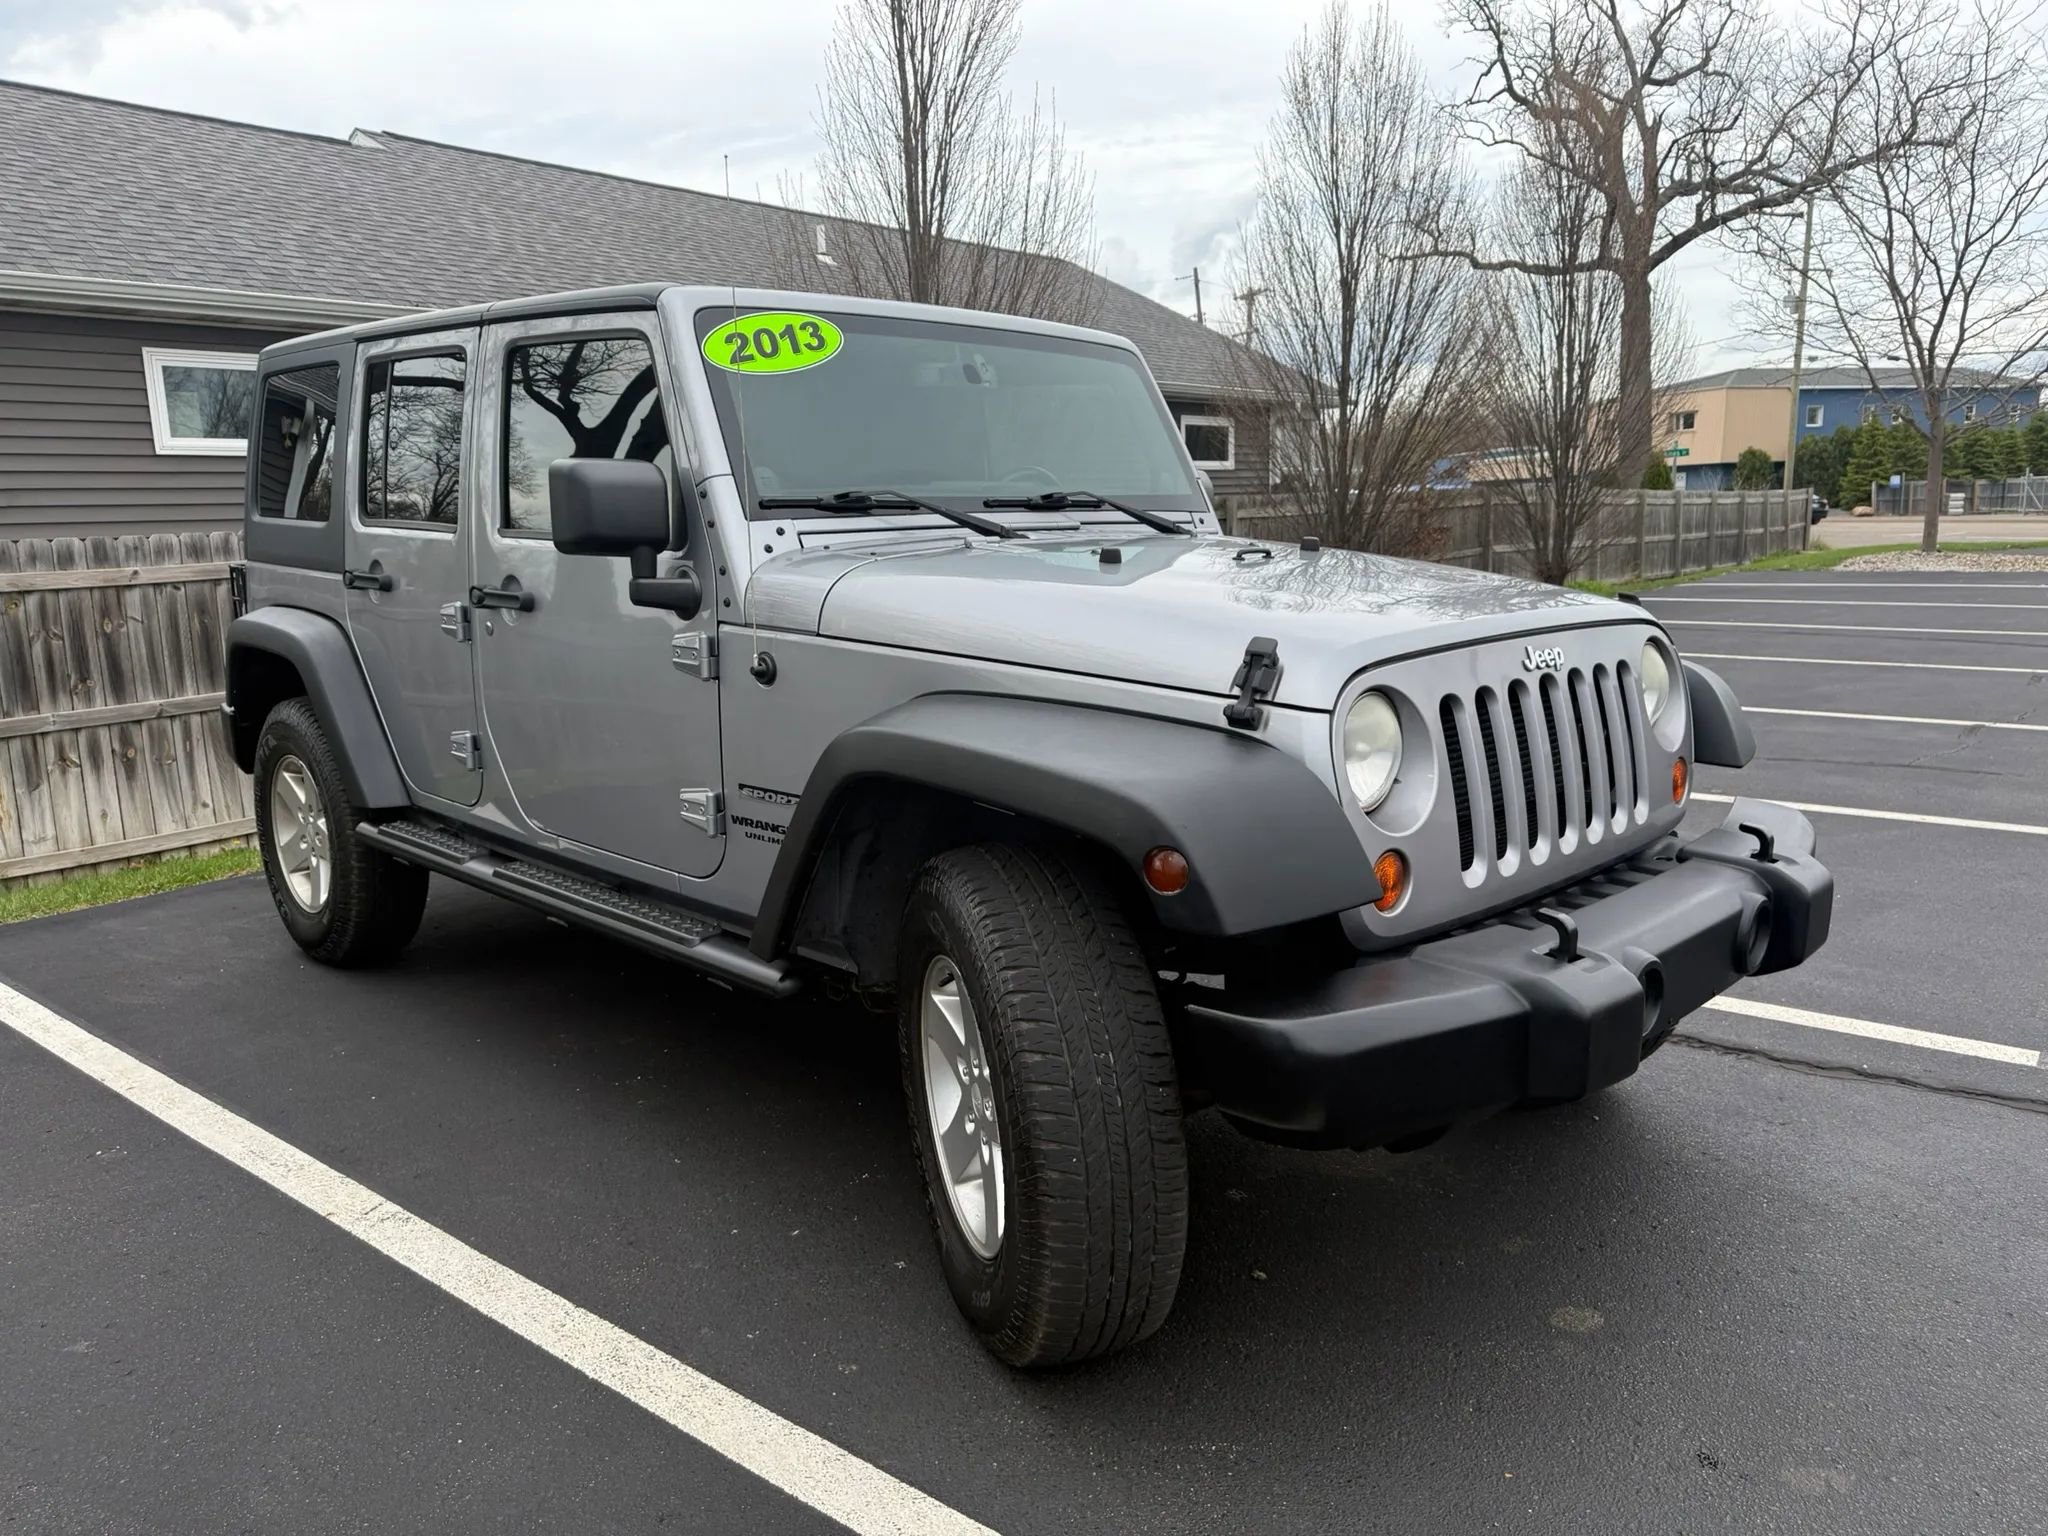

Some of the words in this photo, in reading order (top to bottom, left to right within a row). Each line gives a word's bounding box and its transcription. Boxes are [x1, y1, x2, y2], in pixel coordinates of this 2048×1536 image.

[724, 320, 827, 365] 2013
[1522, 645, 1564, 672] Jeep
[739, 785, 801, 805] SPORT
[731, 814, 788, 835] WRANG
